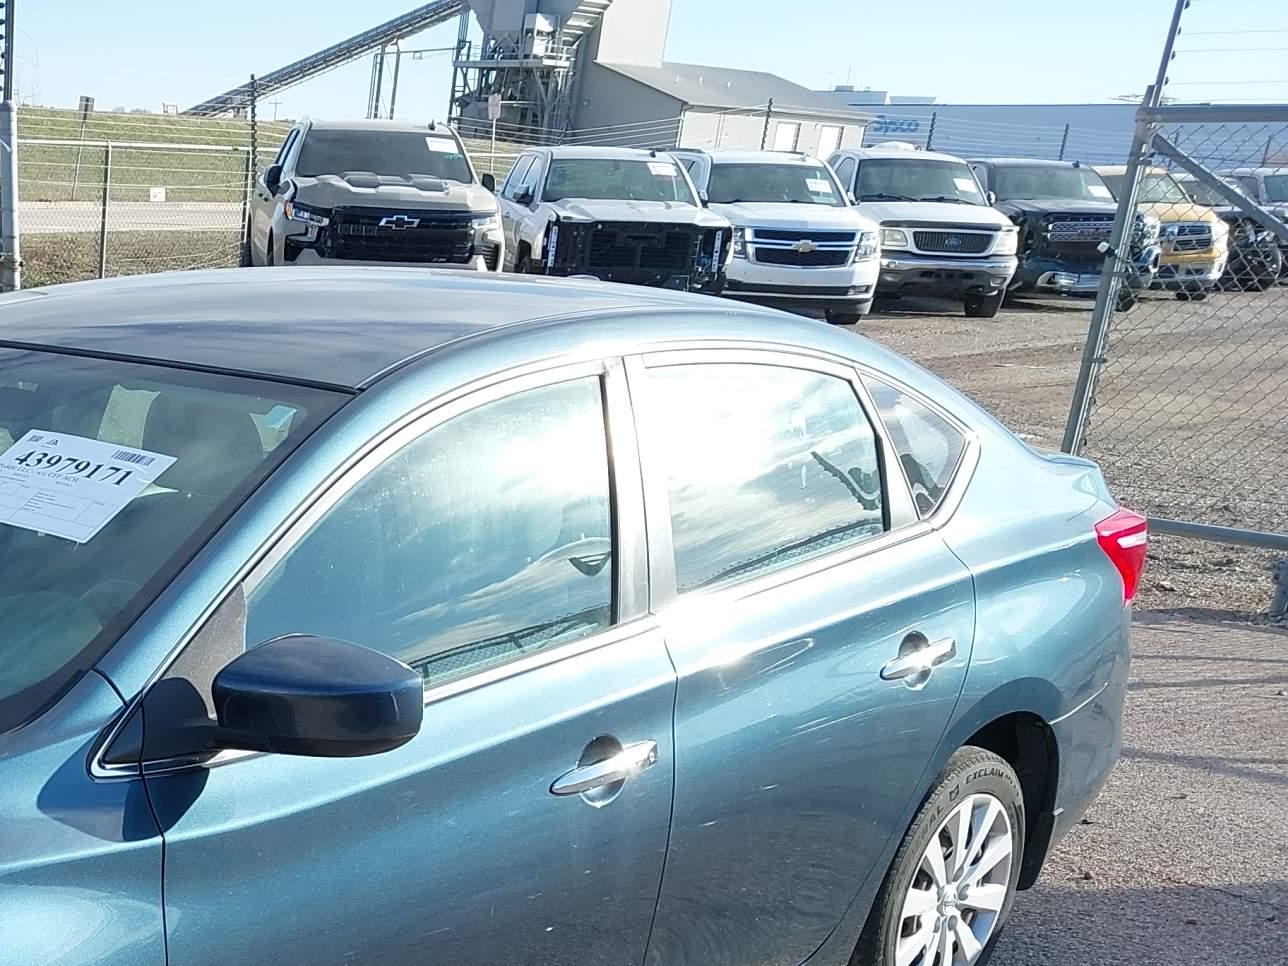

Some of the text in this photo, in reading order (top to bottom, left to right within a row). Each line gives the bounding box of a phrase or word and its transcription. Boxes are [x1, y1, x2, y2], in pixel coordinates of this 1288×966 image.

[873, 115, 919, 133] Sysco
[14, 450, 133, 486] 43979171
[965, 767, 1004, 784] EXCLAIM
